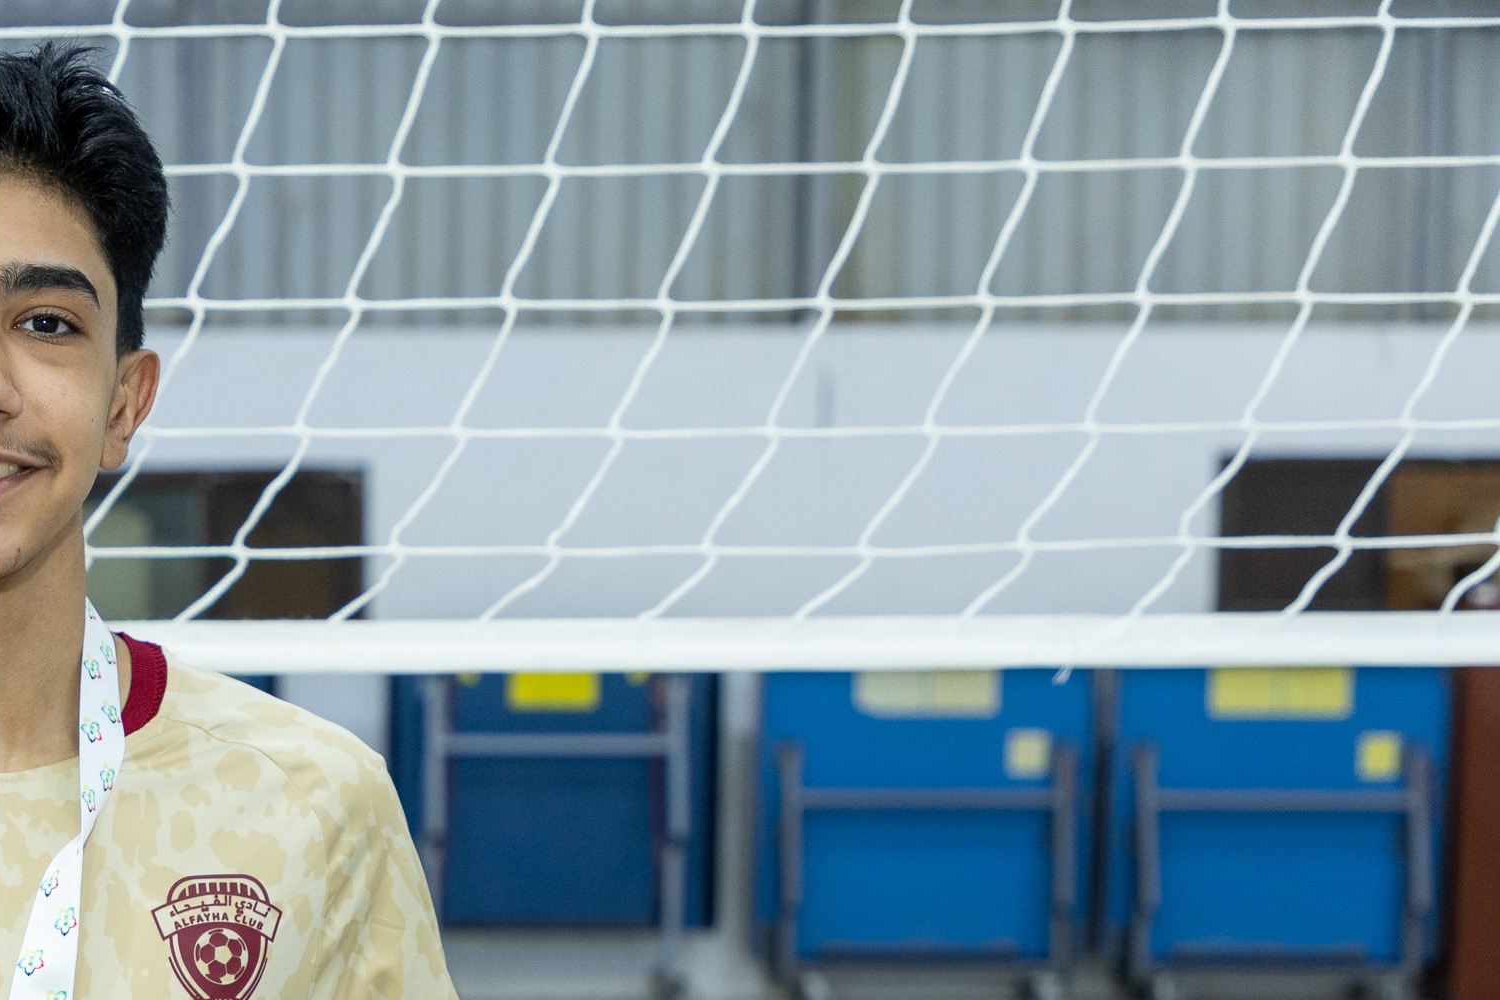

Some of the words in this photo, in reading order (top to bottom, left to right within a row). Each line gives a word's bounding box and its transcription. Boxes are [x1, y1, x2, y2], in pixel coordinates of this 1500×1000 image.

[170, 894, 231, 917] الفيحاء
[235, 900, 271, 918] نادي
[173, 912, 229, 930] ALFAYHA
[234, 914, 264, 930] CLUB
